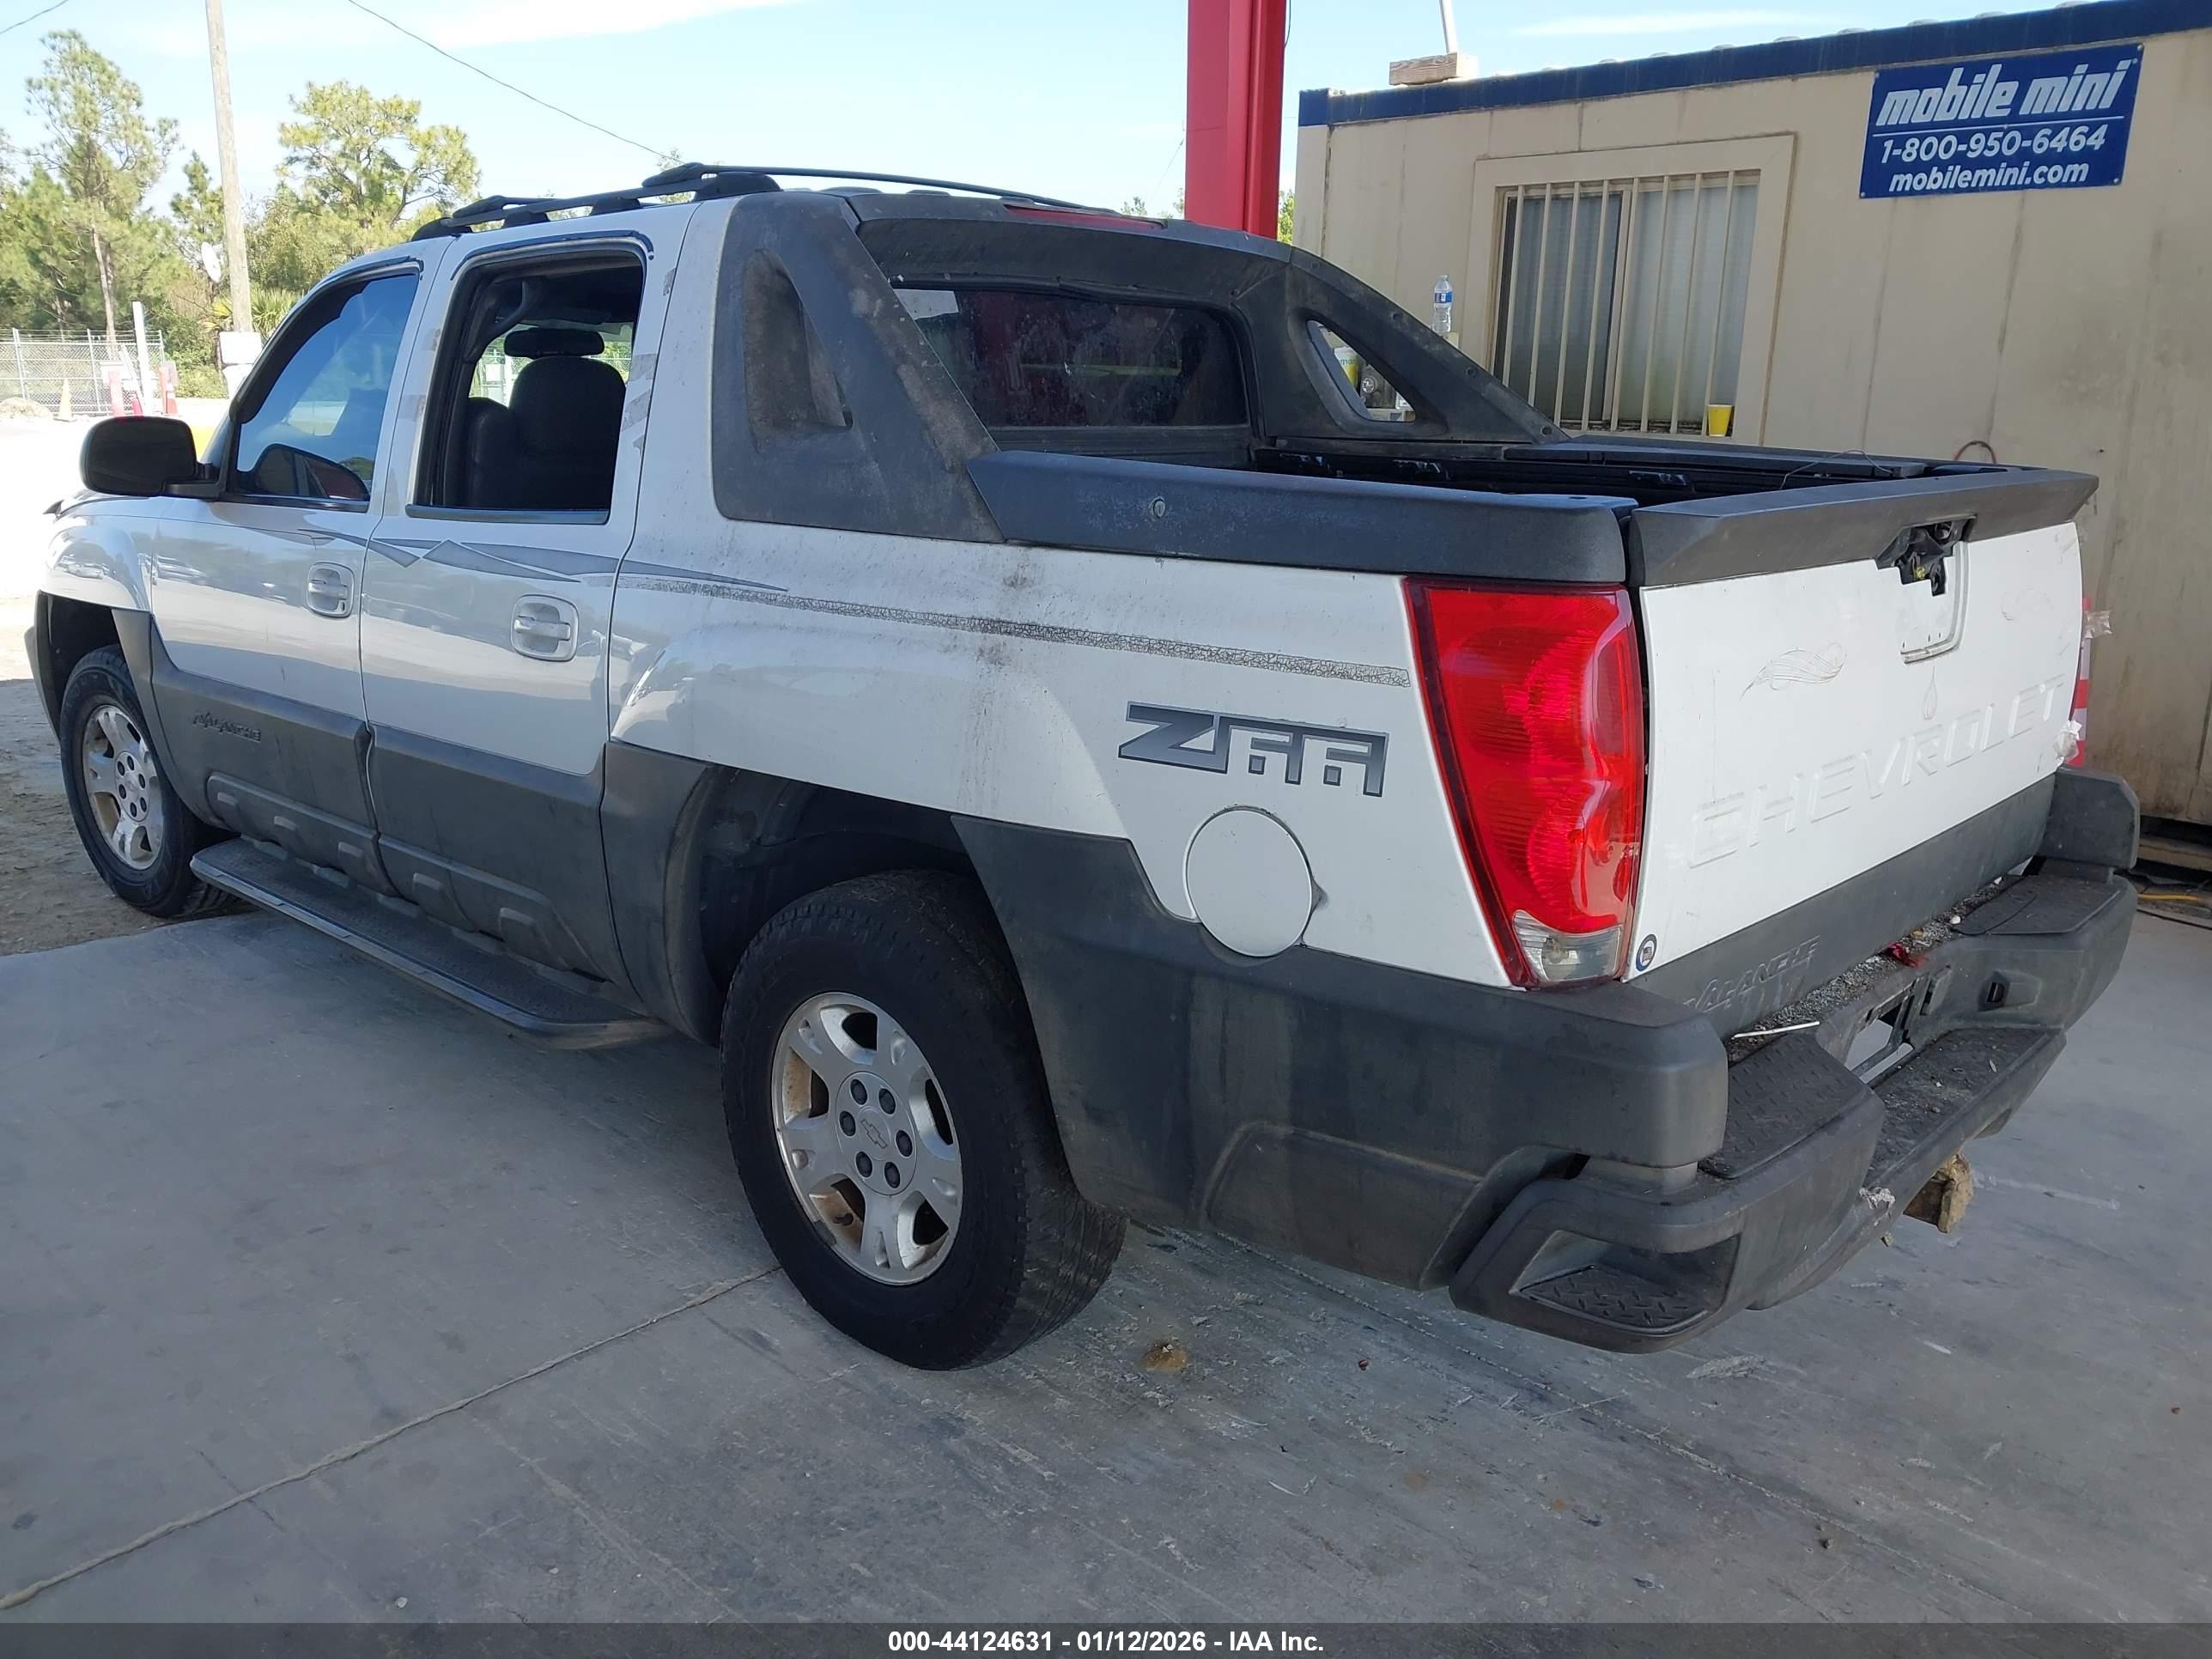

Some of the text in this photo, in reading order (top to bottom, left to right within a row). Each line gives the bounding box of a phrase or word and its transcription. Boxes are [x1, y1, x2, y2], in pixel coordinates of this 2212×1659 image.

[1875, 59, 2131, 126] mobile mini
[1881, 125, 2106, 163] 1-800-950-6464
[1889, 161, 2089, 191] mobilemini.com
[1688, 674, 2065, 869] CHEVROLET
